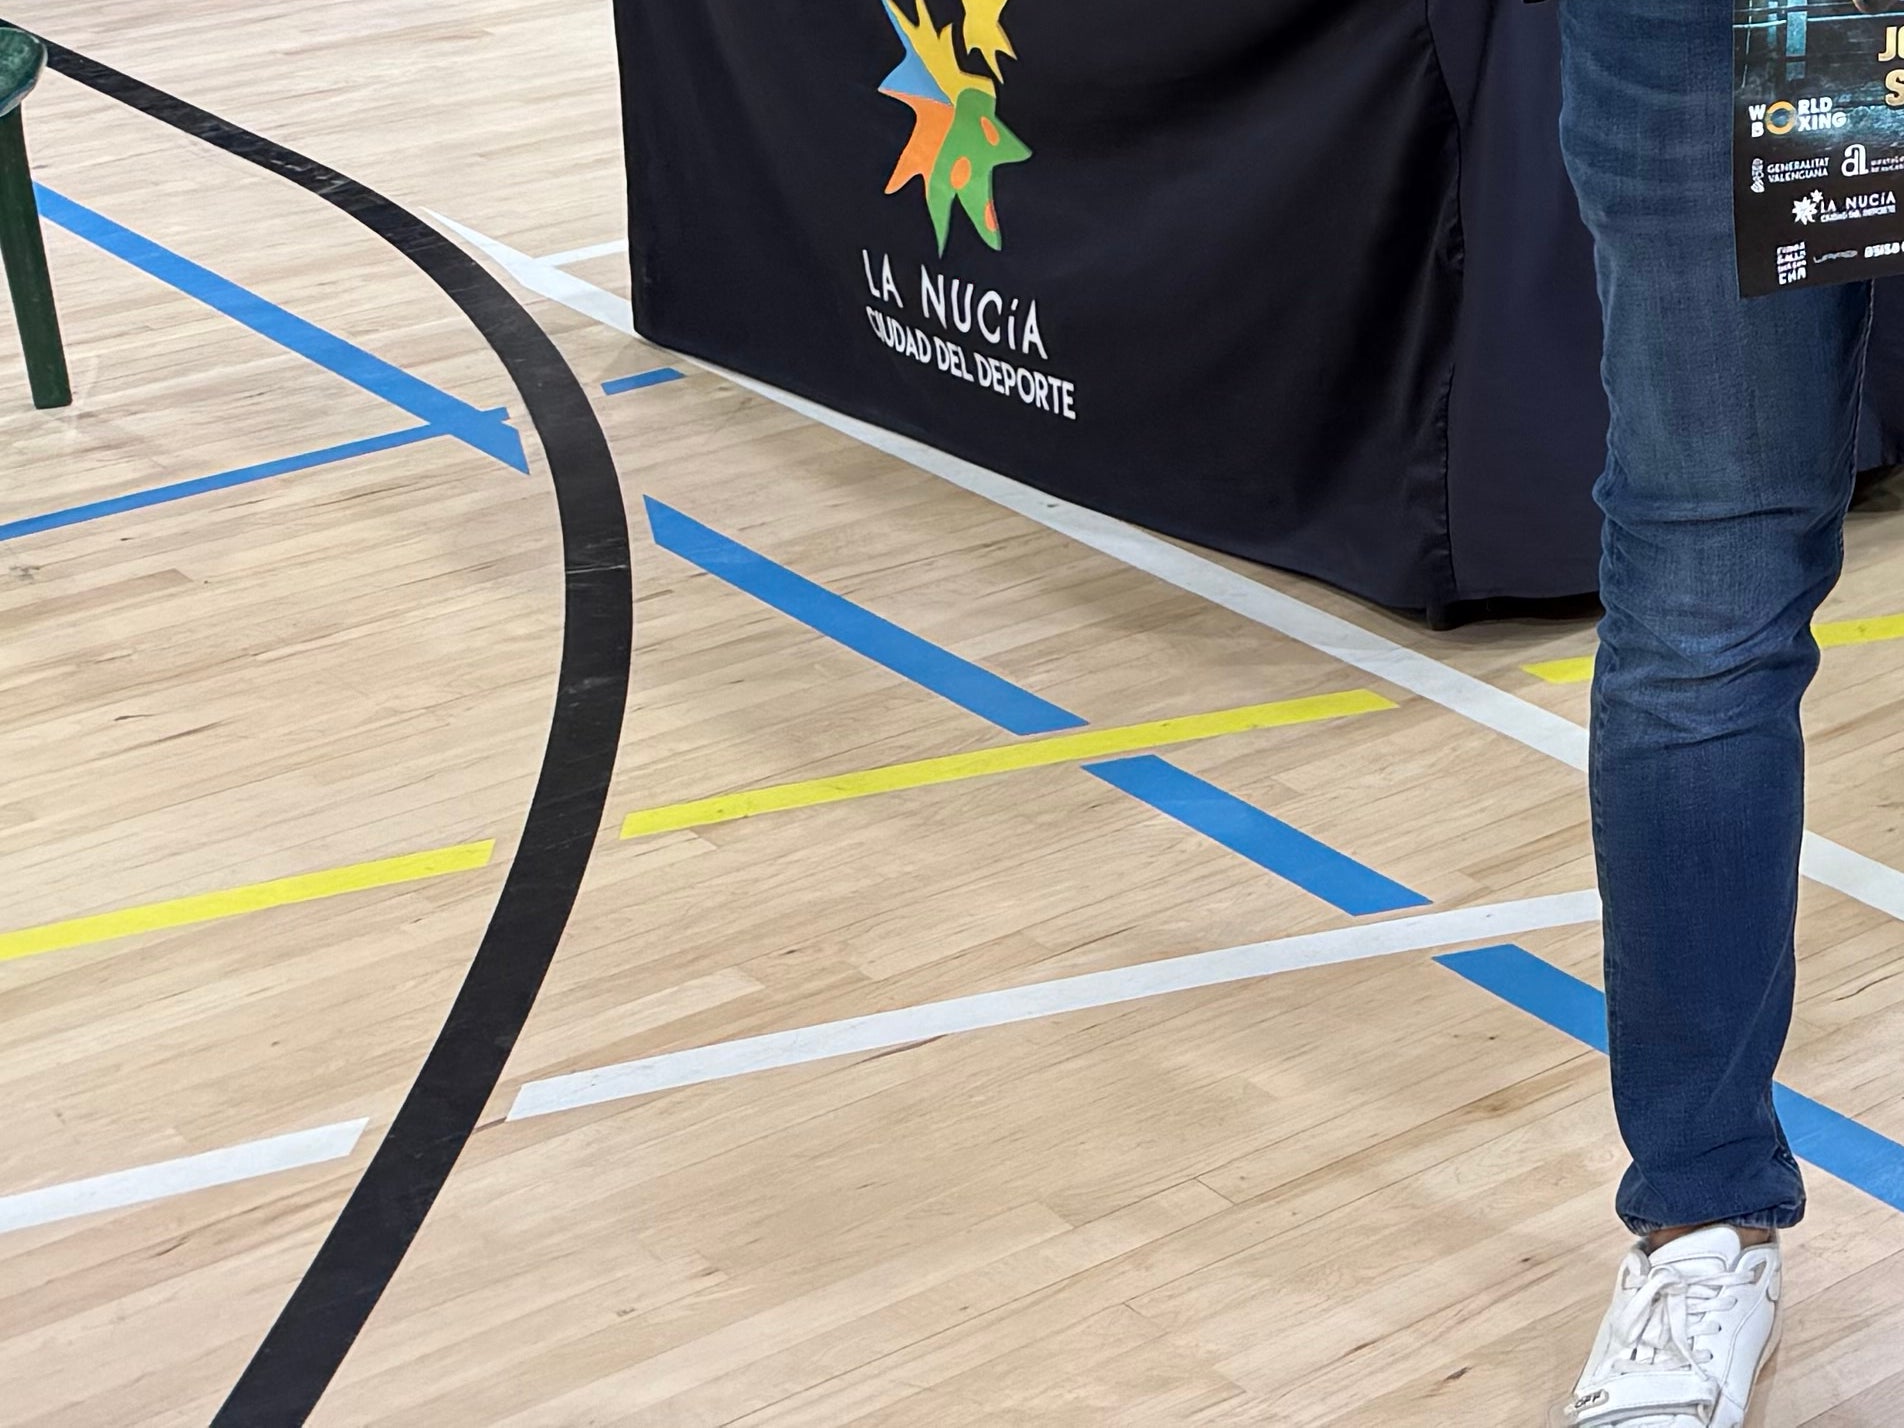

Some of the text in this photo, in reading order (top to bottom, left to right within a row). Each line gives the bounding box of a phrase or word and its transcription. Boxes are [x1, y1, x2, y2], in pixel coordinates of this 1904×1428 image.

[1820, 199, 1836, 213] LA
[862, 249, 904, 308] LA
[866, 305, 1077, 420] CIUDAD DEL DEPORTE
